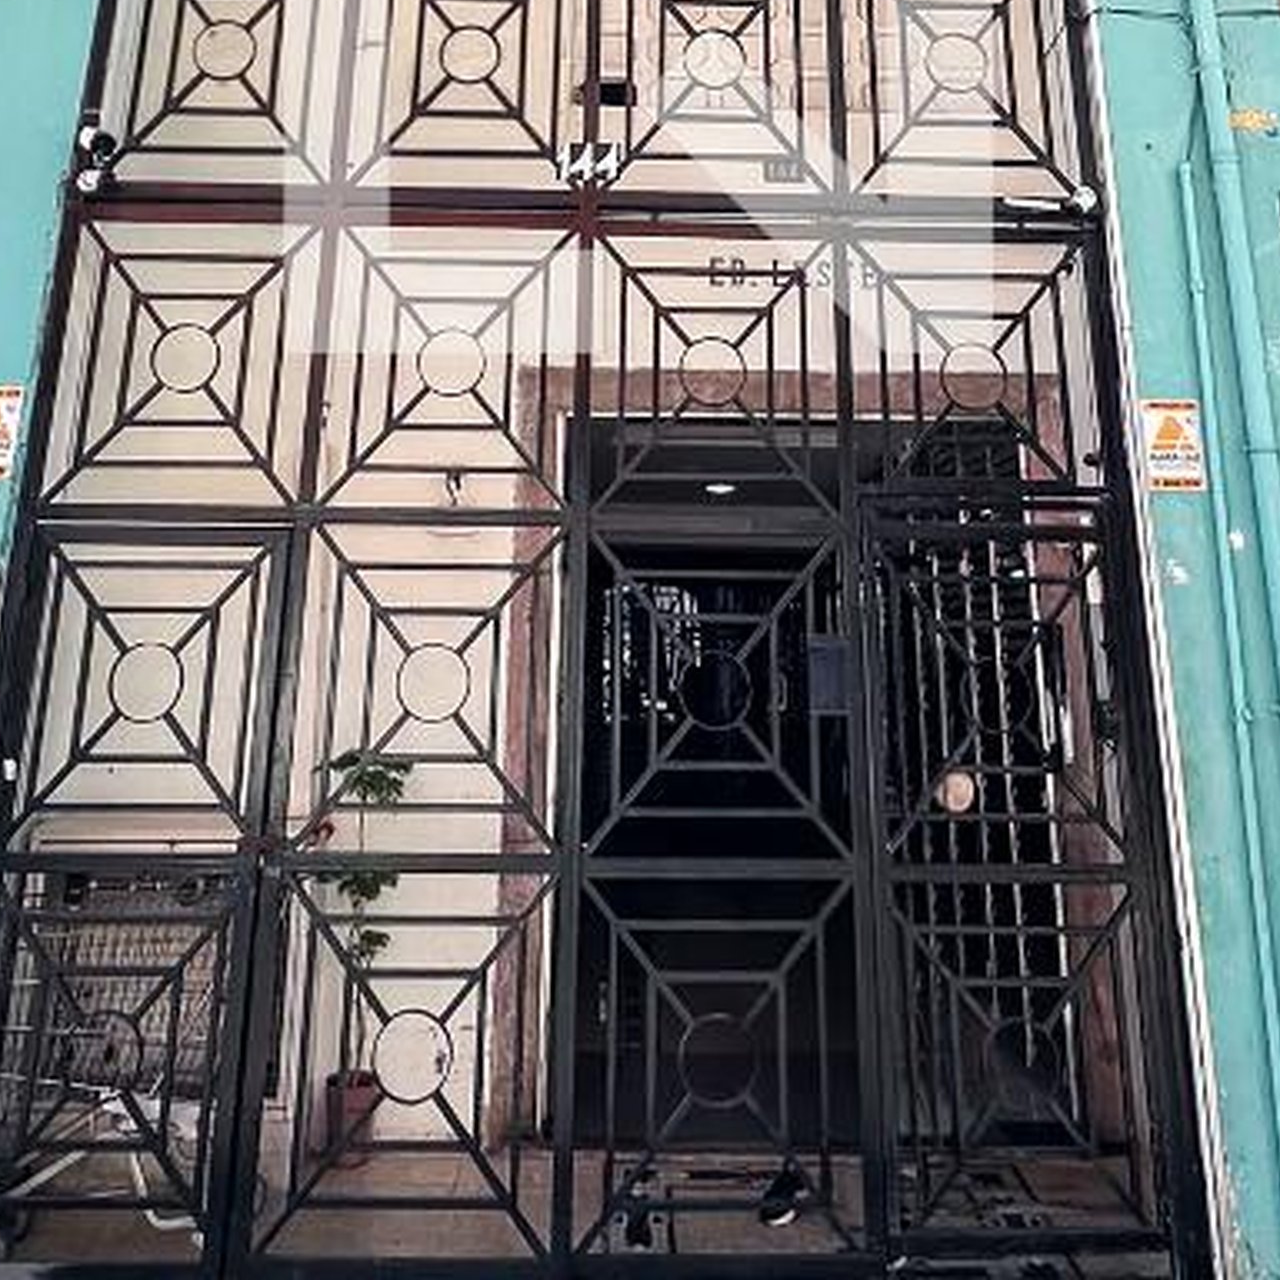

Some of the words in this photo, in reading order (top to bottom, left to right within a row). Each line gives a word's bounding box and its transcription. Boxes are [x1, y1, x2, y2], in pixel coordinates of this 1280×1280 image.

[556, 143, 619, 180] 144
[709, 257, 757, 288] ED.
[772, 258, 878, 289] LSE
